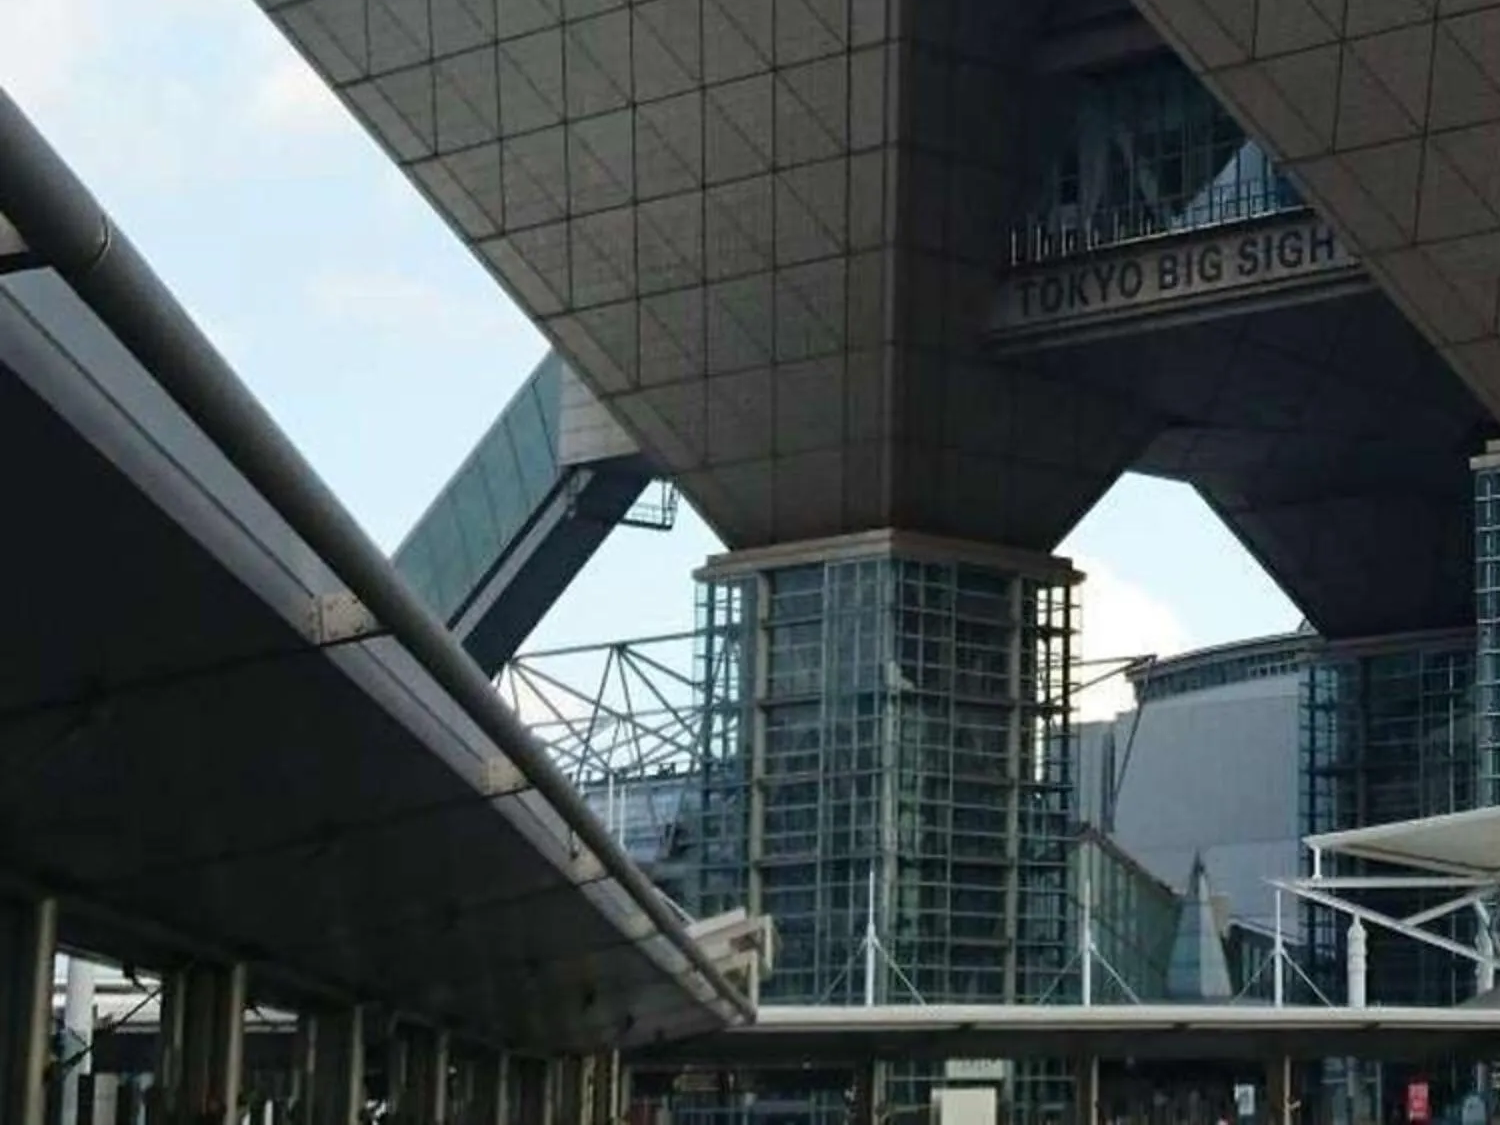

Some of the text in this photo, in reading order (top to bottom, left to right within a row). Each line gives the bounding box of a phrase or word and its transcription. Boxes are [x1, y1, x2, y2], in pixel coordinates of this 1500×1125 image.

[1016, 226, 1335, 316] TOKYO BIG SIGH
